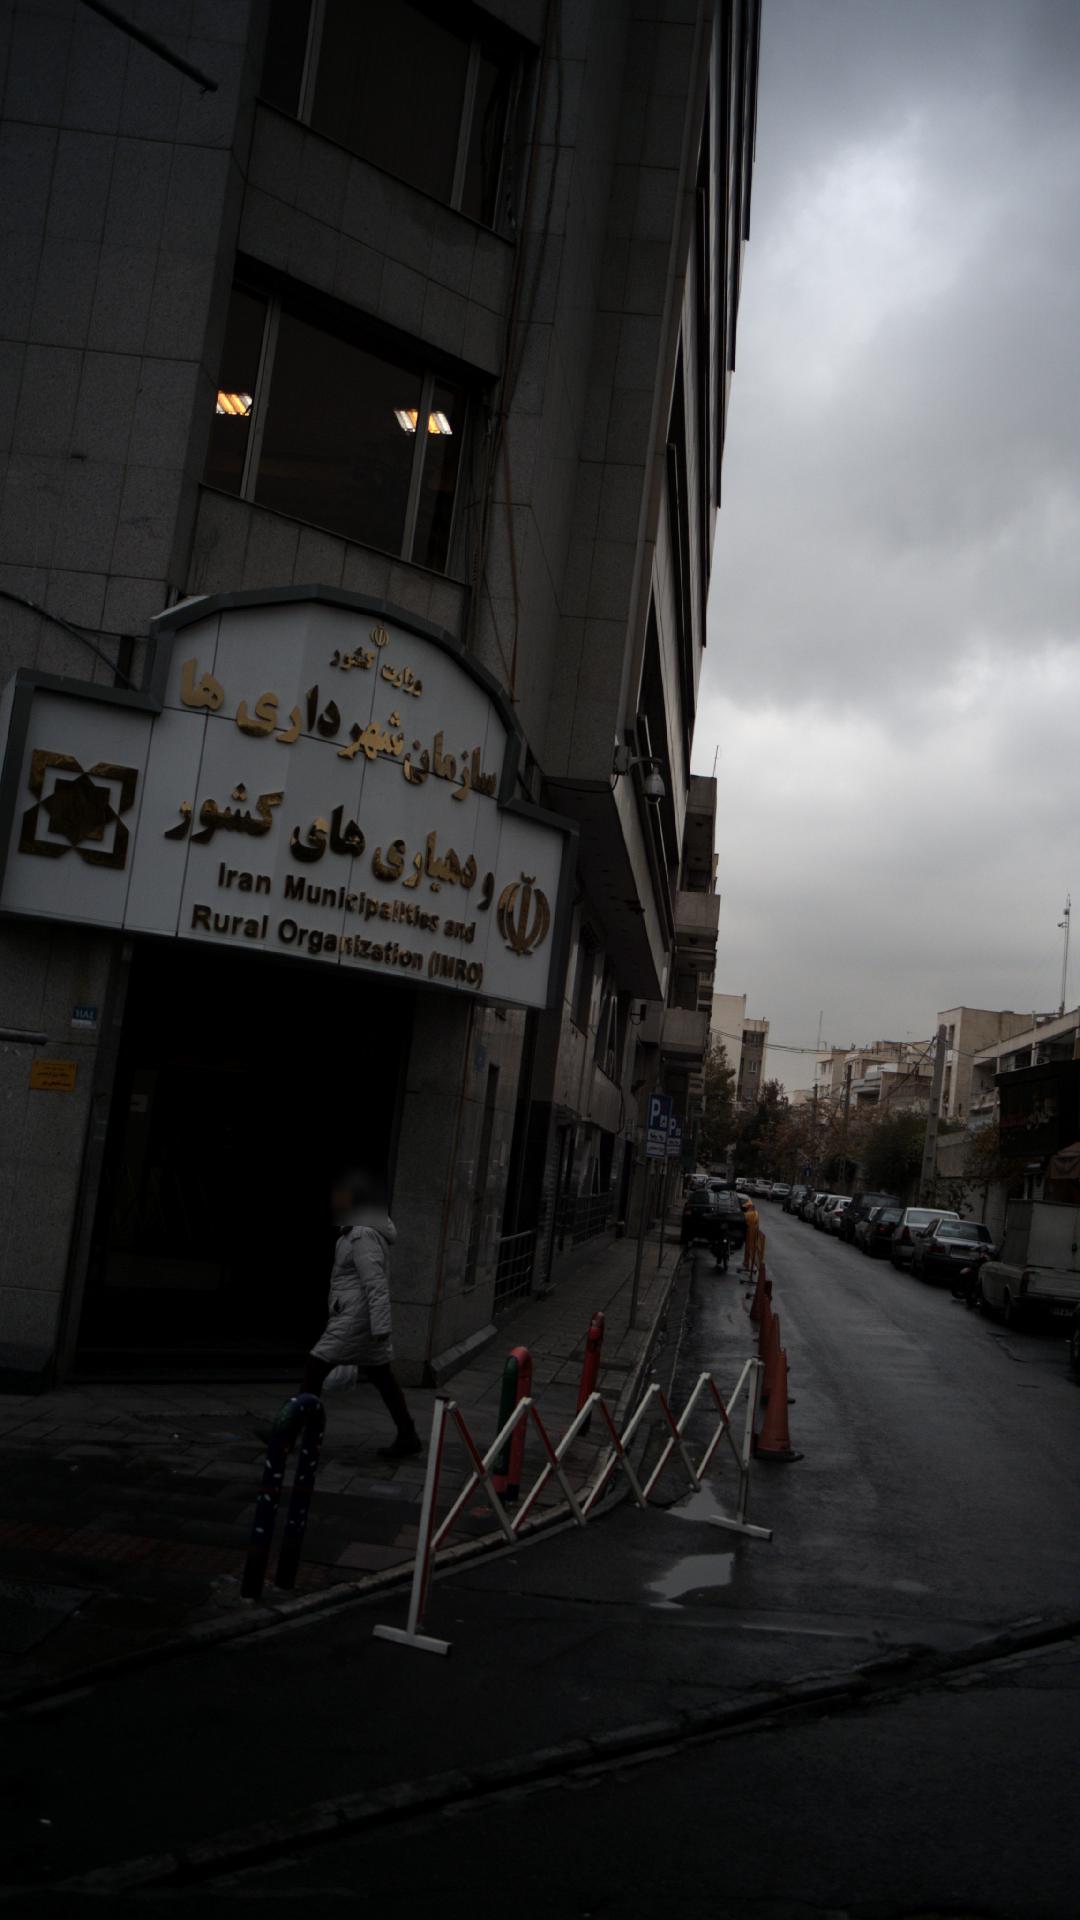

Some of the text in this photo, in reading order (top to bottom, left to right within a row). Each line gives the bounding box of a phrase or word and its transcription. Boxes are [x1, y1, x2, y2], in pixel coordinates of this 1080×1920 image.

[180, 657, 225, 711] ها
[330, 647, 422, 697] وزارت کشور
[402, 731, 497, 800] سازمان
[165, 783, 284, 844] کشور
[290, 805, 366, 863] های
[371, 831, 477, 893] دهیاری
[218, 862, 477, 944] Iran Municipalities and
[191, 904, 485, 990] Rural Organization (IMRO)
[650, 1098, 661, 1127] P
[668, 1118, 677, 1136] P
